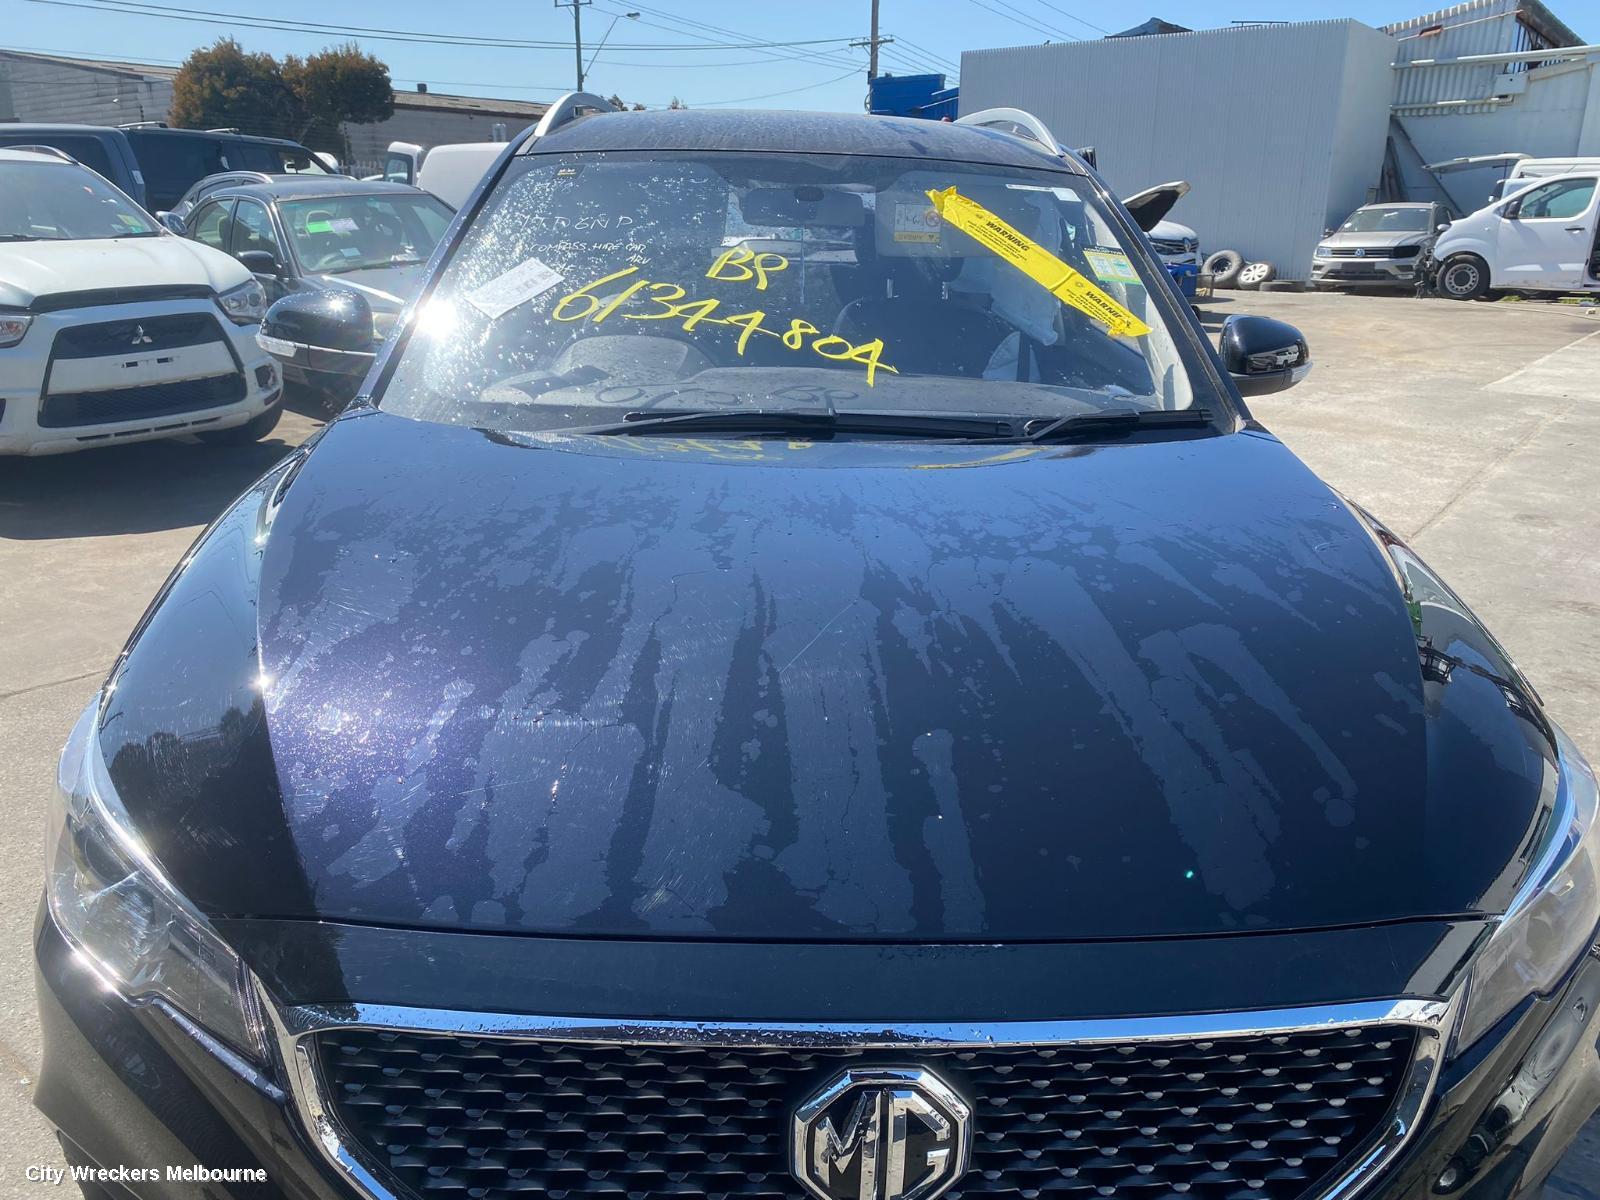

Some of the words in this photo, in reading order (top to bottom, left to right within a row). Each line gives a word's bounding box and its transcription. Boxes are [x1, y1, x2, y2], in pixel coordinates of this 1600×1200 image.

[985, 220, 1031, 252] WARNING
[704, 245, 789, 291] BP
[813, 1090, 951, 1200] MG
